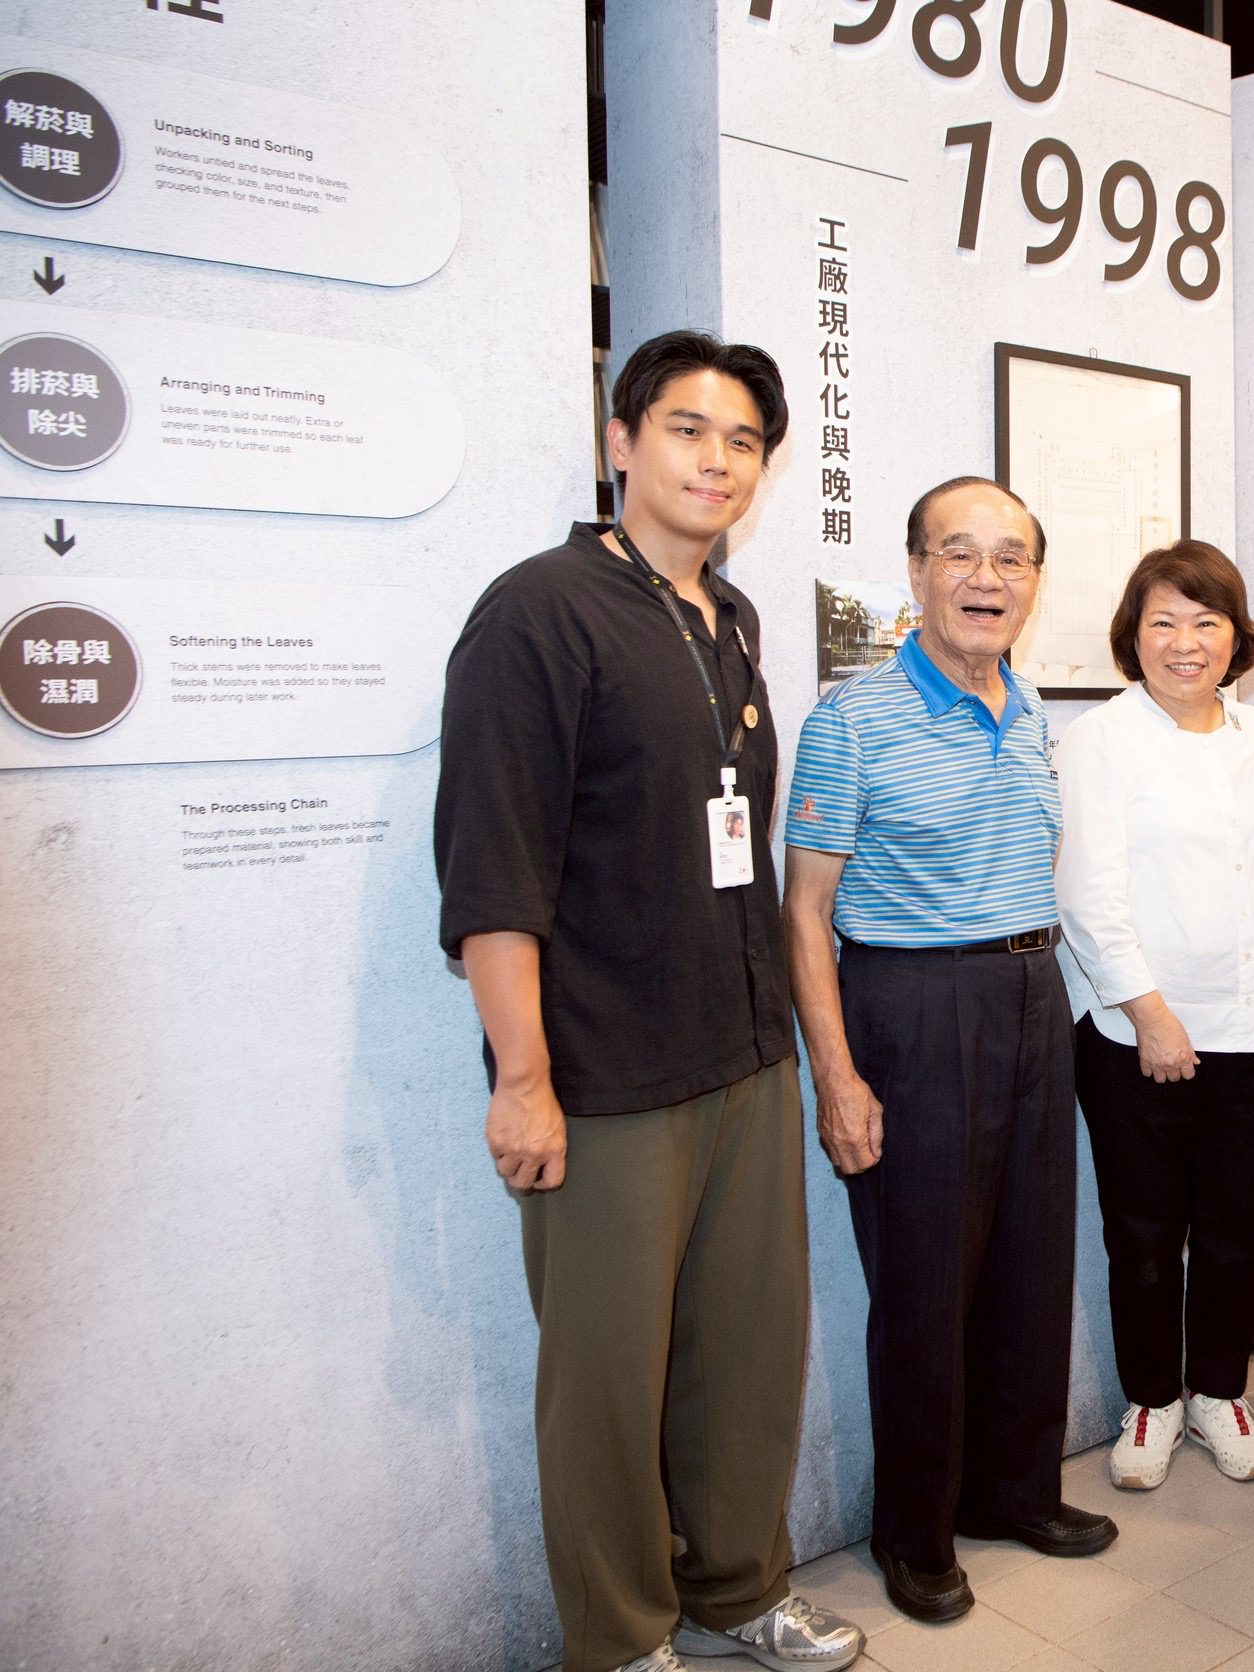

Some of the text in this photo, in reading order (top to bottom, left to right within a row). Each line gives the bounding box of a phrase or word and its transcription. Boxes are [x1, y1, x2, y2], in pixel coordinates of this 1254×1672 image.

[748, 0, 1068, 104] 80
[4, 98, 95, 140] 解菸與
[154, 118, 314, 162] Unpacking and Sorting
[19, 141, 82, 177] 調理
[155, 146, 200, 163] Workers
[203, 153, 235, 169] untied
[238, 161, 258, 173] and
[261, 165, 295, 181] spread
[298, 172, 313, 183] the
[155, 162, 203, 181] checking
[206, 170, 234, 185] color,
[264, 180, 283, 193] and
[325, 191, 346, 203] then
[155, 179, 200, 195] grouped
[203, 185, 230, 199] them
[233, 190, 247, 201] for
[250, 193, 265, 205] the
[268, 198, 289, 209] next
[944, 121, 1226, 302] 1998
[10, 366, 100, 399] 排菸與
[160, 376, 325, 405] Arranging and Trimming
[818, 217, 851, 545] 工廠現代化與晚期
[27, 409, 87, 438] 除尖
[160, 404, 199, 416] Leaves
[202, 408, 228, 418] were
[230, 408, 249, 420] laid
[252, 413, 269, 422] out
[305, 416, 331, 427] Extra
[334, 420, 344, 428] or
[161, 421, 364, 445] uneven parts were trimmed so each leaf
[162, 436, 183, 445] was
[187, 437, 216, 449] ready
[219, 439, 233, 449] for
[236, 440, 270, 452] further
[22, 639, 112, 666] 除骨與
[169, 635, 314, 650] Softening the Leaves
[170, 662, 199, 672] Thick
[202, 663, 233, 672] stems
[264, 663, 307, 671] removed
[310, 663, 319, 671] to
[322, 662, 349, 671] make
[351, 662, 383, 671] leaves
[39, 678, 98, 705] 濕潤
[213, 677, 257, 687] Moisture
[284, 677, 313, 686] added
[317, 678, 329, 686] so
[332, 677, 352, 687] they
[355, 676, 386, 687] stayed
[172, 693, 207, 704] steady
[210, 692, 243, 703] during
[245, 692, 268, 701] later
[180, 798, 328, 816] The Processing Chain
[182, 830, 224, 840] Through
[228, 828, 256, 838] these
[291, 824, 315, 833] fresh
[319, 821, 350, 832] leaves
[352, 819, 390, 830] became
[182, 845, 229, 857] prepared
[278, 838, 319, 849] showing
[321, 836, 342, 846] both
[345, 834, 363, 844] skill
[365, 834, 384, 843] and
[183, 858, 233, 871] teamwork
[237, 858, 246, 866] in
[249, 855, 275, 866] every
